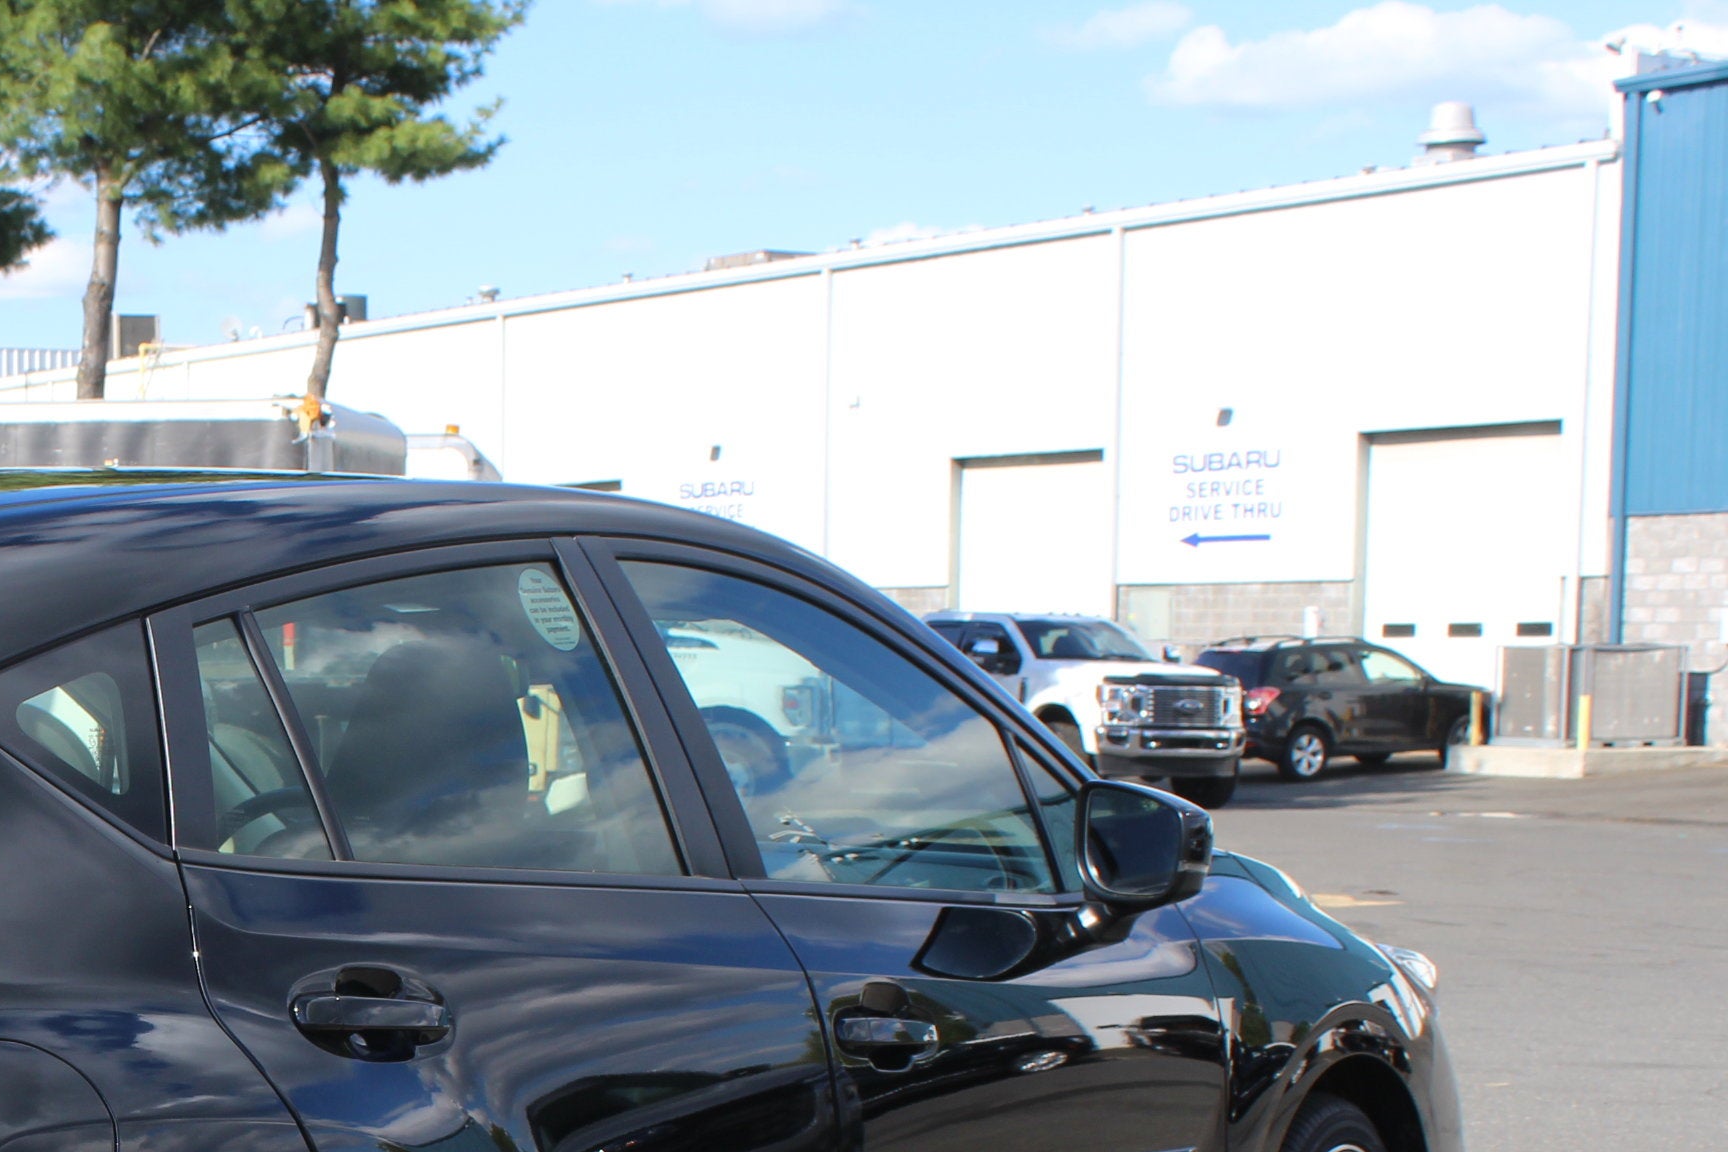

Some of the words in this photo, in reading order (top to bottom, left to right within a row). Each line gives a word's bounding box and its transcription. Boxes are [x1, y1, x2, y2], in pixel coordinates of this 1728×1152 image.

[1173, 449, 1281, 474] SUBARU
[679, 481, 754, 499] SUBARU
[1186, 479, 1264, 499] SERVICE
[1169, 504, 1224, 522] DRIVE
[1232, 501, 1282, 519] THRU
